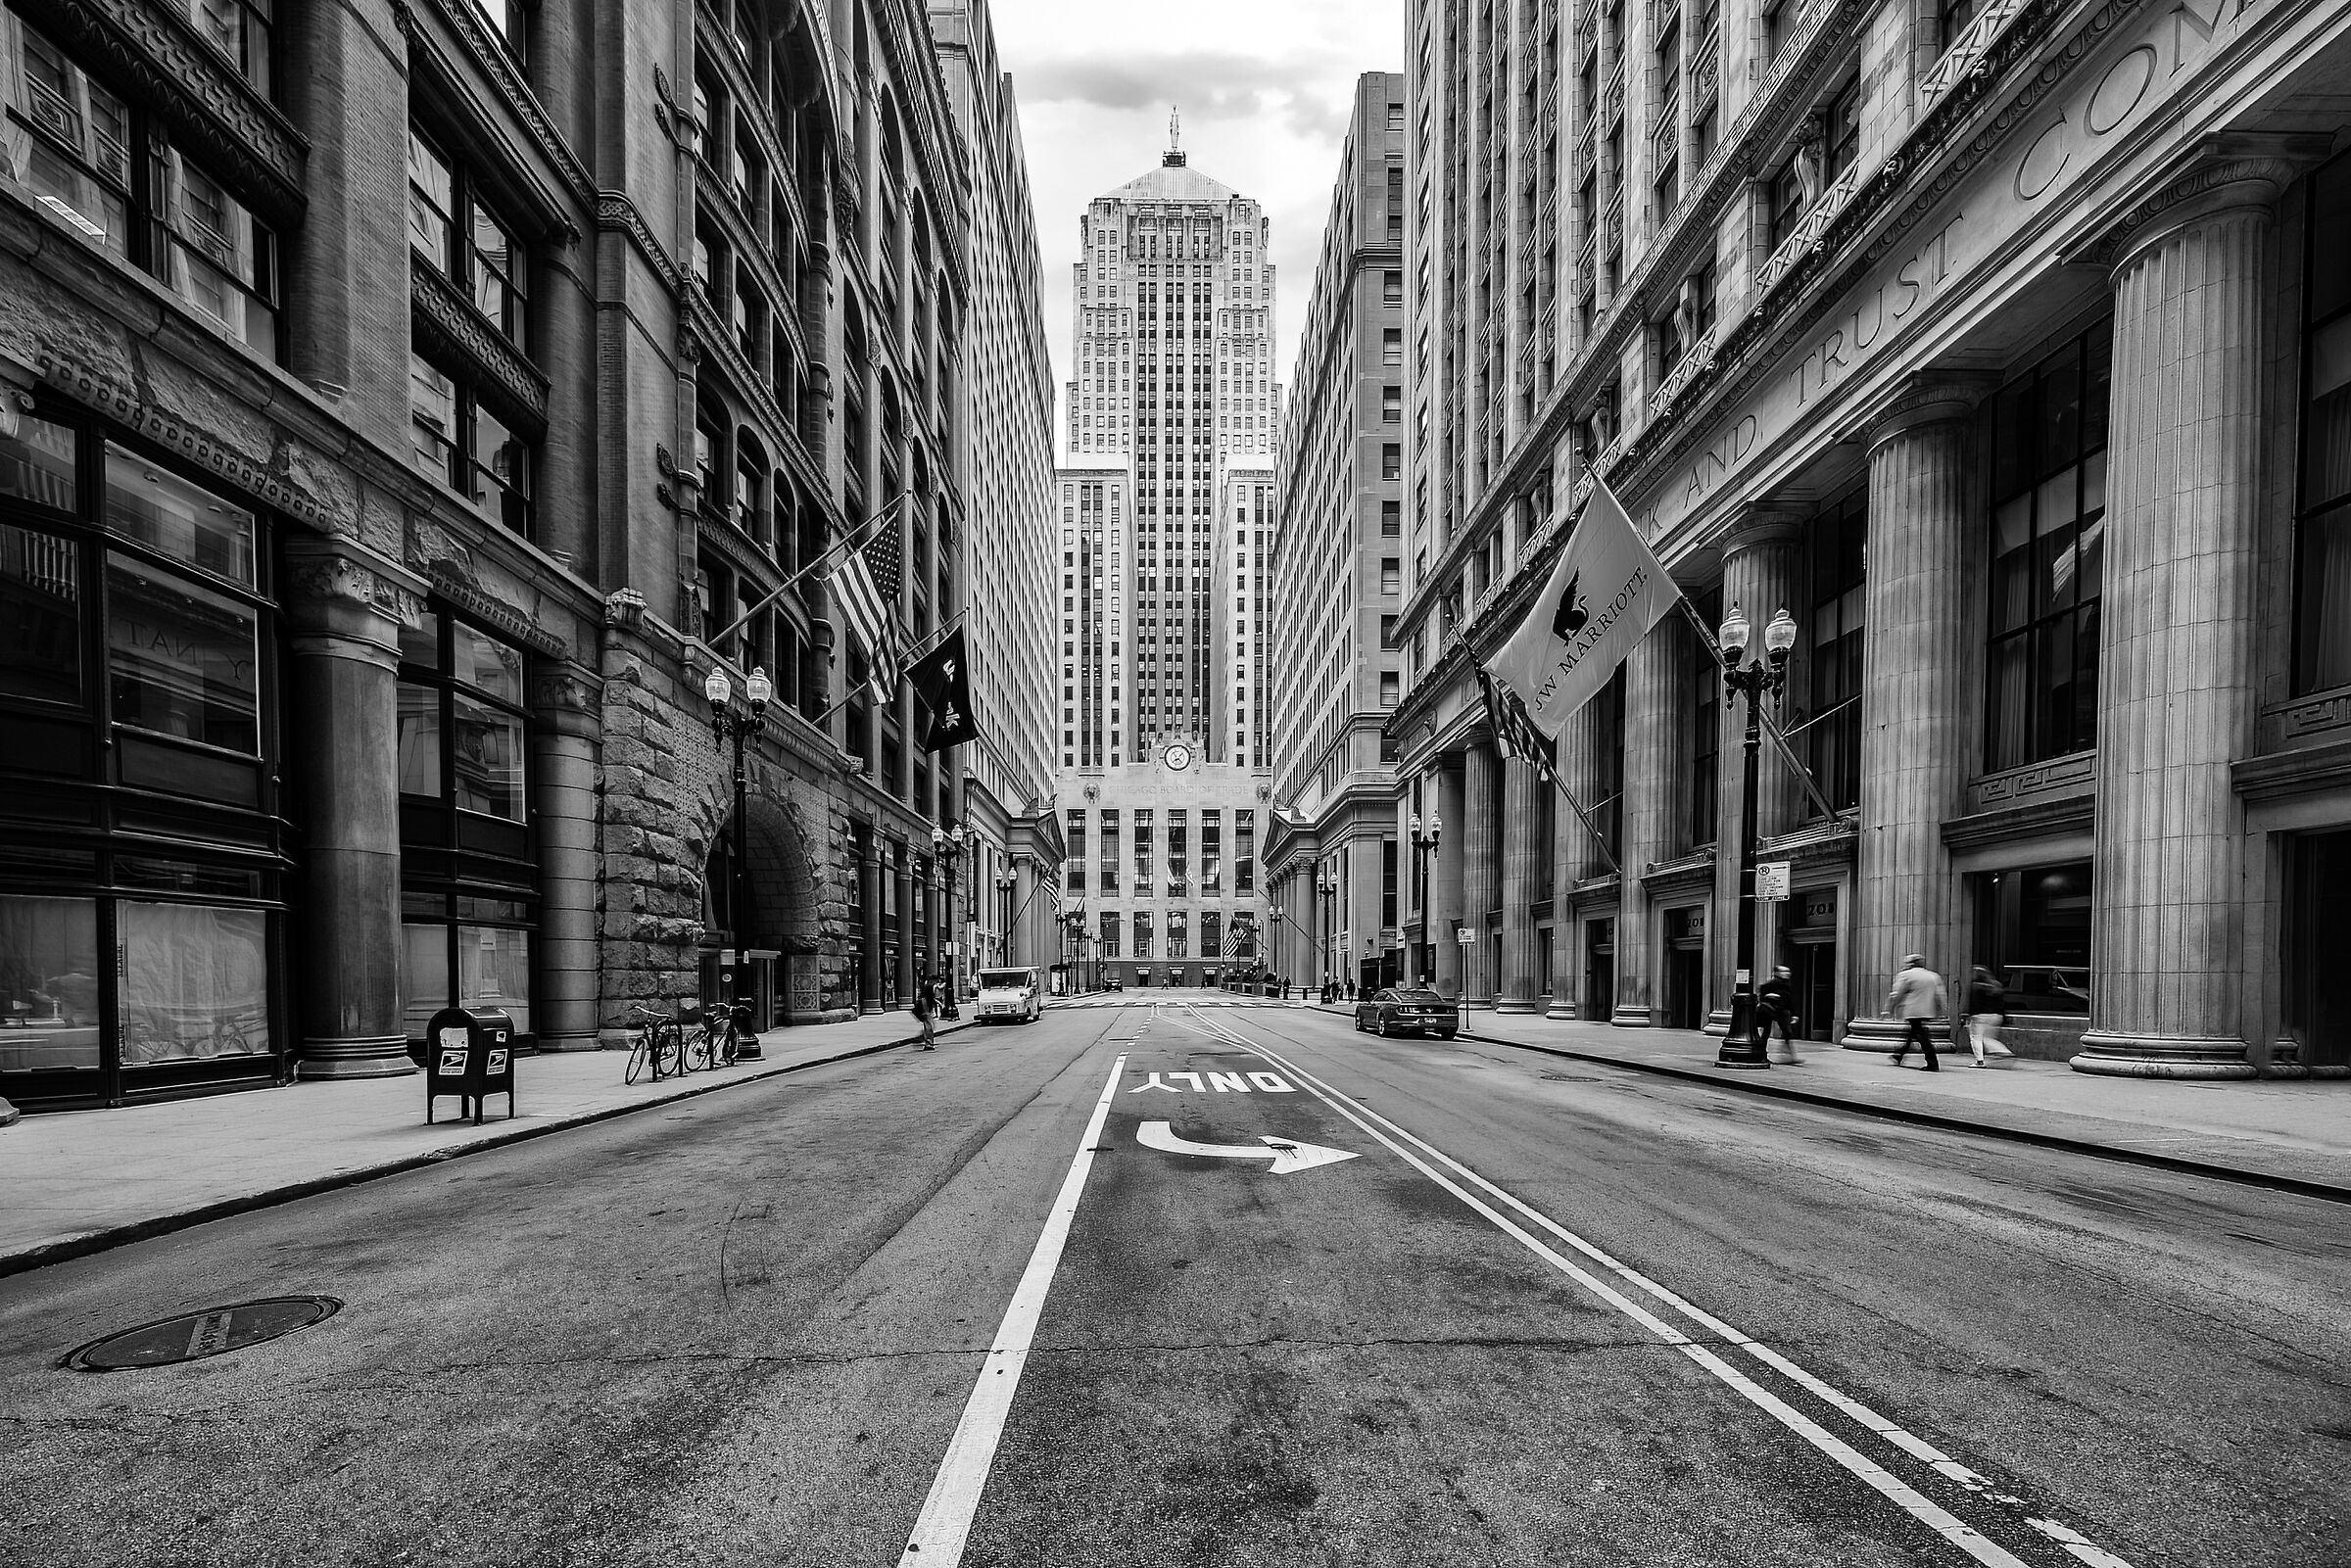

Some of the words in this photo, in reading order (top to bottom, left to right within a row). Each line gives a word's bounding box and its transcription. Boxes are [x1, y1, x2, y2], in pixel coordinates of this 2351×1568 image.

[1684, 414, 1757, 509] AND
[1788, 212, 1964, 408] TRUST
[1535, 674, 1559, 711] JW
[1108, 785, 1157, 794] CHICAGO
[1160, 785, 1194, 794] BOARD
[1199, 785, 1213, 794] OF
[1215, 785, 1248, 794] TRADE
[1128, 1071, 1298, 1093] ONLY
